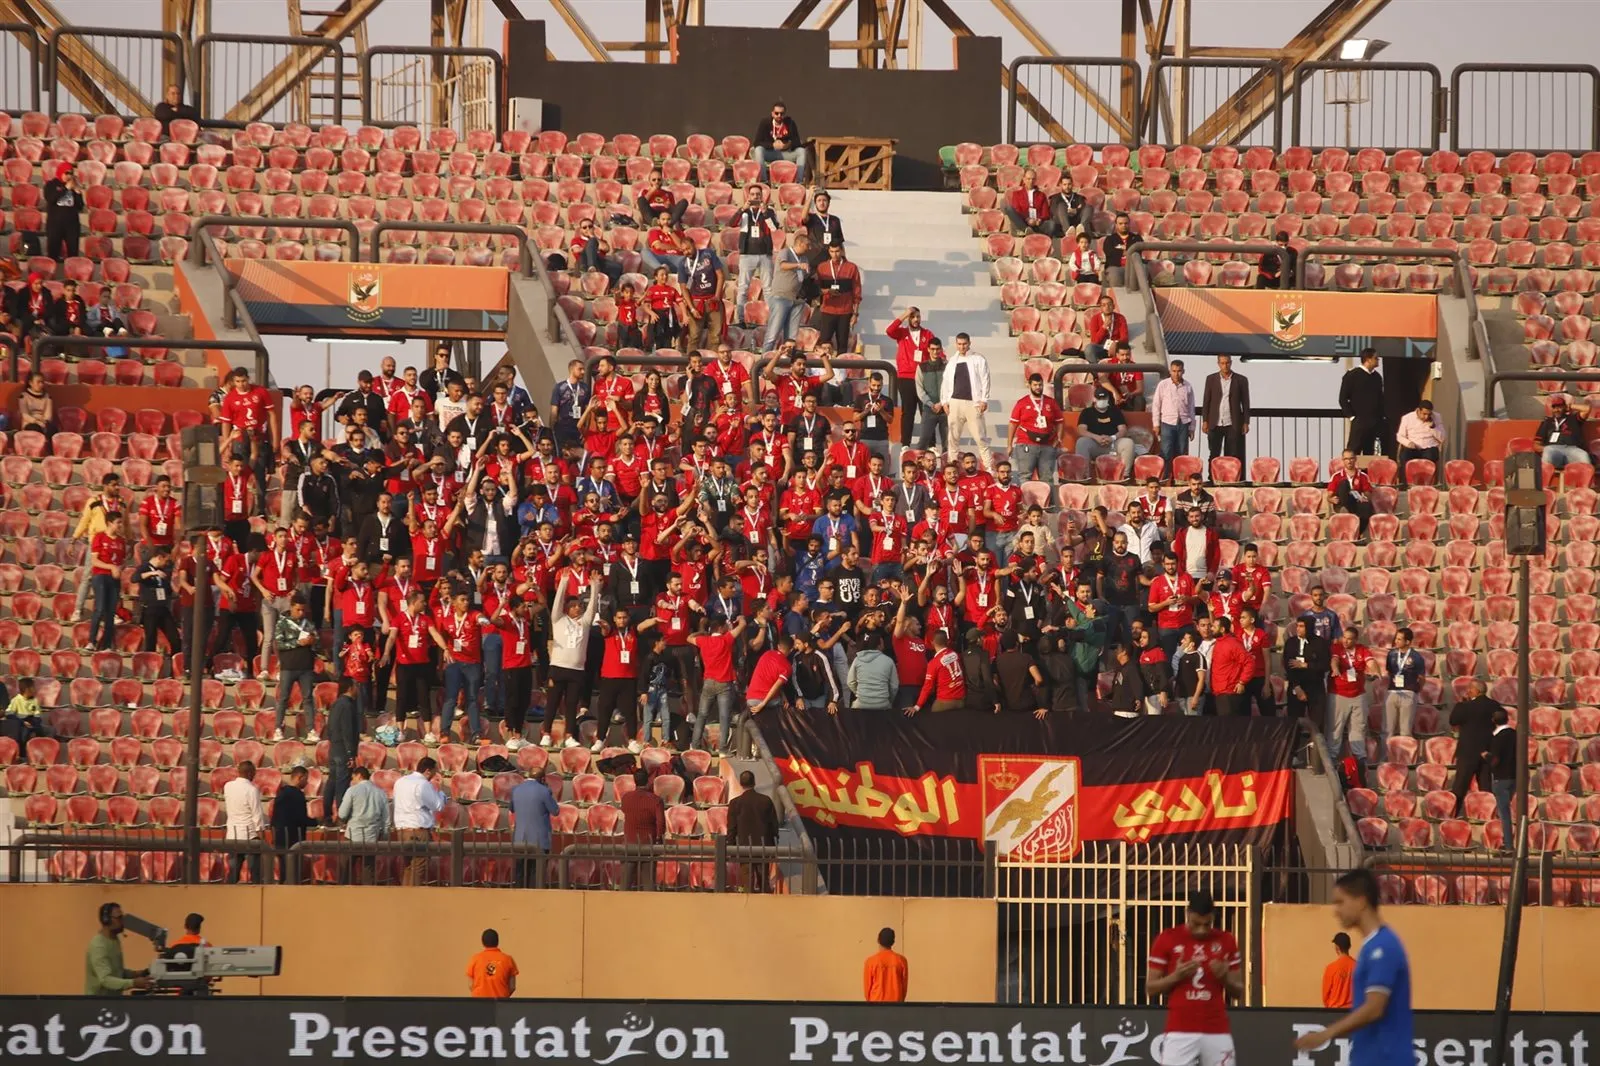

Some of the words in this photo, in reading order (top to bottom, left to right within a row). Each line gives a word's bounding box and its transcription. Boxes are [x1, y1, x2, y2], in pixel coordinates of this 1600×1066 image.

[787, 758, 960, 833] الوطنية
[1113, 772, 1258, 842] نادي
[288, 1010, 729, 1065] Presentation
